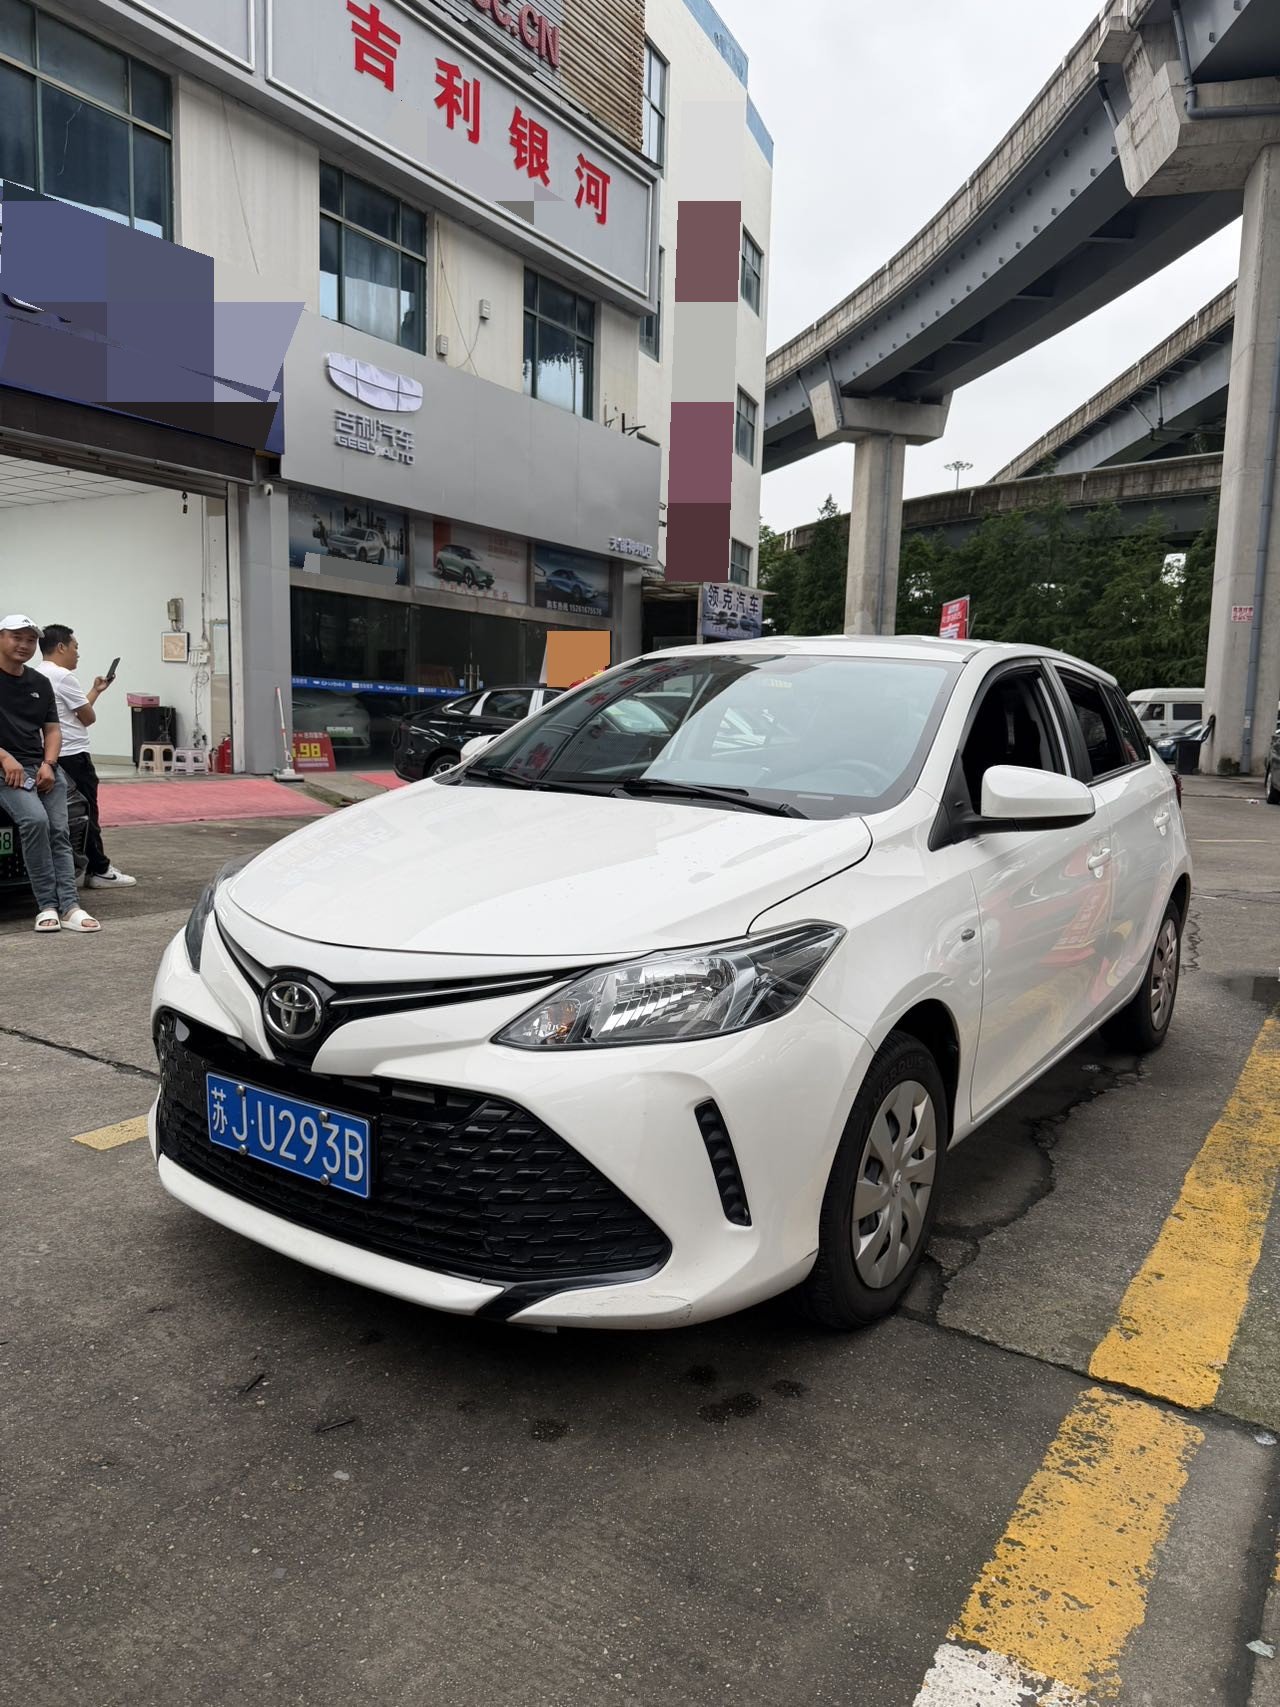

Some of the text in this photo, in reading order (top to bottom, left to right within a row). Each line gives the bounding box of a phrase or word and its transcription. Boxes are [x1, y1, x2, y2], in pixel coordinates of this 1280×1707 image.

[474, 0, 560, 68] C.CN
[347, 0, 611, 225] 吉利银河
[335, 410, 415, 450] 吉利汽车
[708, 585, 759, 616] 领克汽车
[210, 1086, 364, 1182] 苏J·U293B
